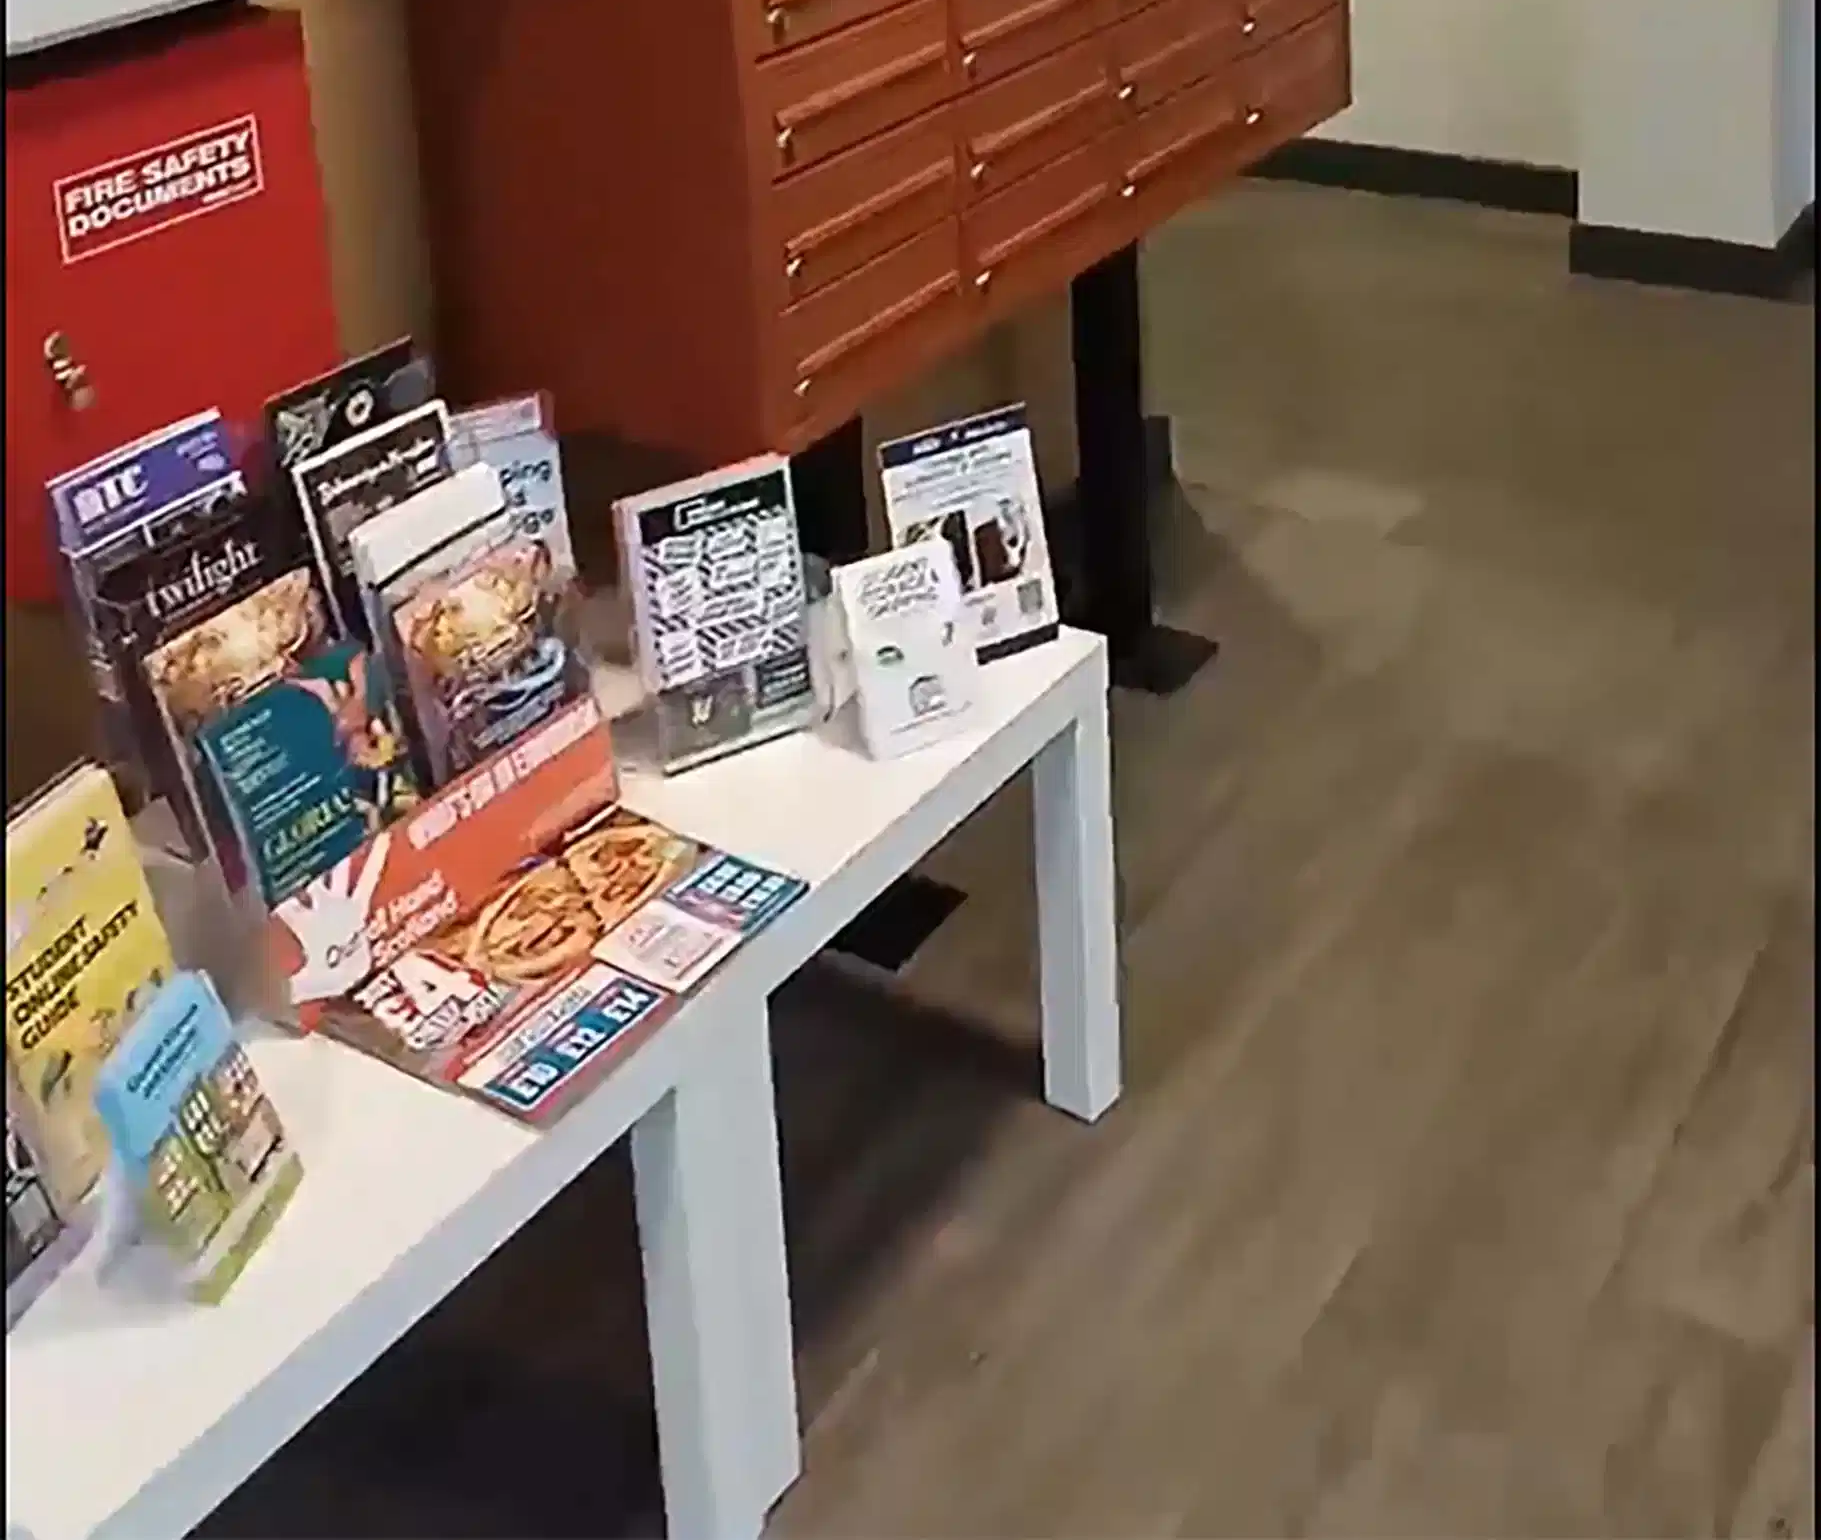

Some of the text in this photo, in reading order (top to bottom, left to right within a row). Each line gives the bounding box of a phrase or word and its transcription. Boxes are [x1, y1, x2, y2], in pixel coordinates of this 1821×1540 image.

[65, 130, 251, 214] FIRE SAFETY
[68, 155, 251, 238] DOCUMENTS
[145, 539, 263, 618] twilight
[4, 915, 89, 1002] STUDENT
